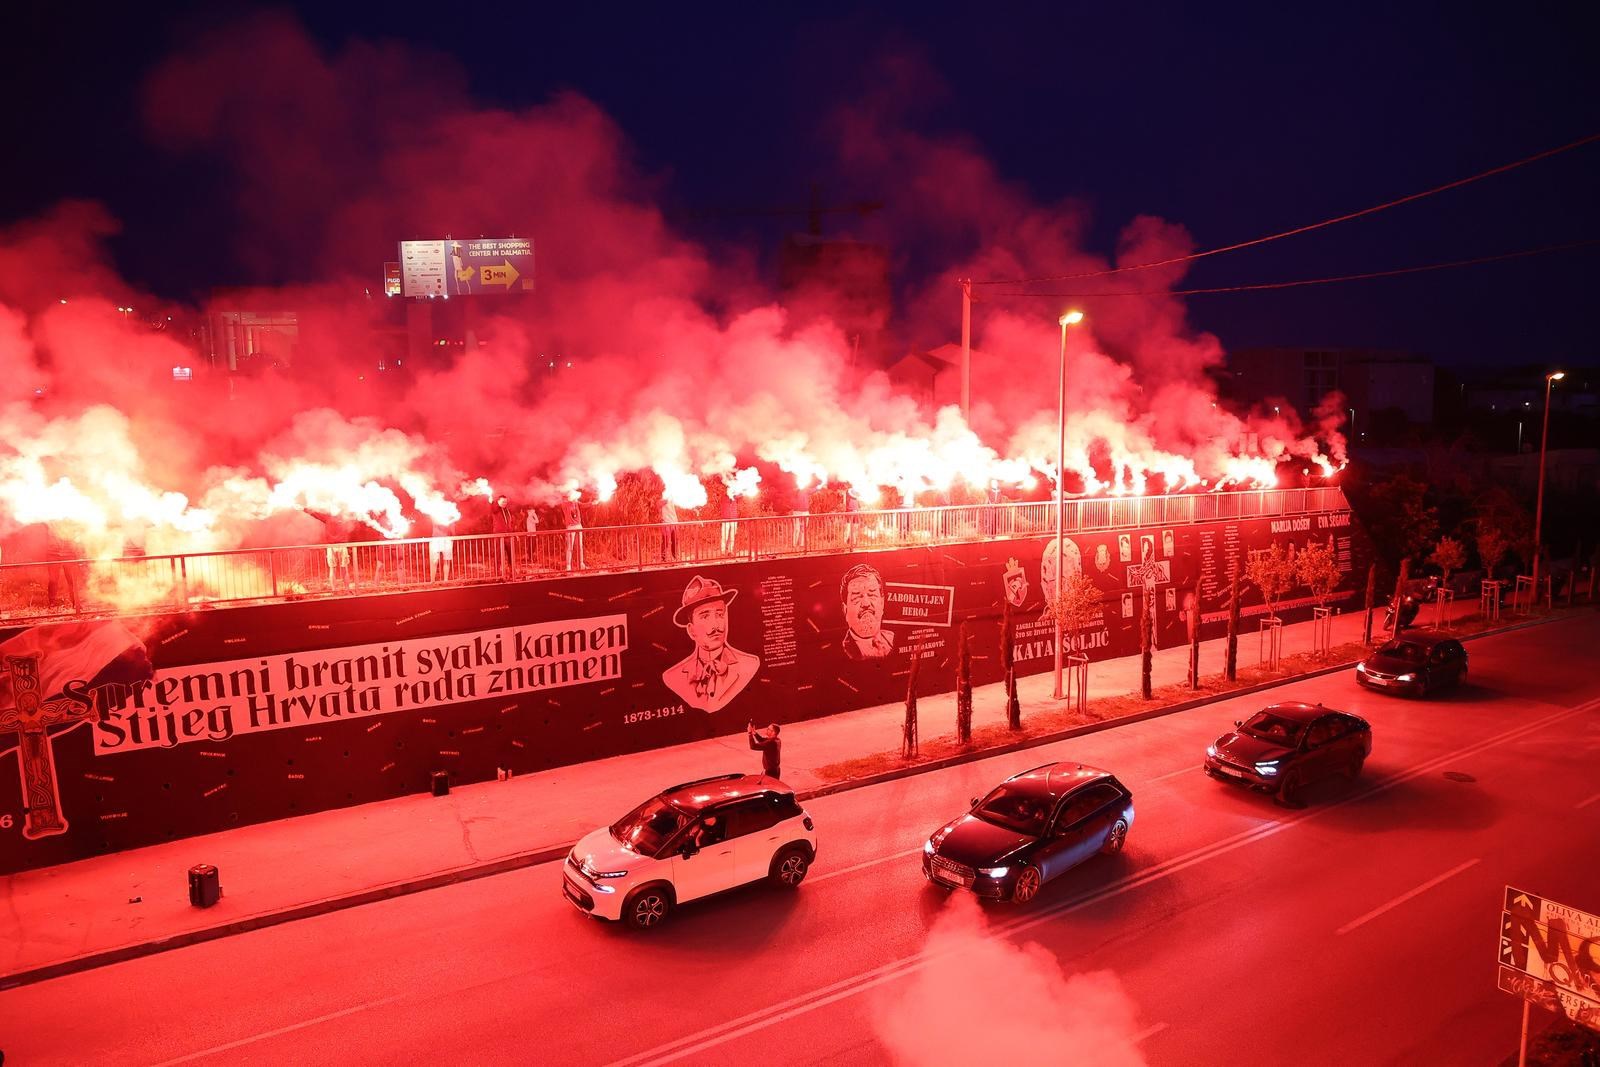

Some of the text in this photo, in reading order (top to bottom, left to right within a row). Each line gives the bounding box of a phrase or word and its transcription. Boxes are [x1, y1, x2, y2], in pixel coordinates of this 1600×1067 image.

[498, 241, 530, 249] SHOPPING
[484, 269, 506, 281] 3 MIN
[1318, 515, 1329, 528] EVA
[886, 592, 945, 605] ZABORAVLJEN
[902, 606, 928, 617] HEROJ
[1012, 626, 1110, 662] KATA ŠOLJIĆ
[63, 623, 627, 721] Spremni branit svaki kamen
[97, 653, 619, 748] Stijeg Hrvata roda znamen
[623, 705, 685, 725] 1873-1914
[1546, 903, 1583, 923] OLIVA
